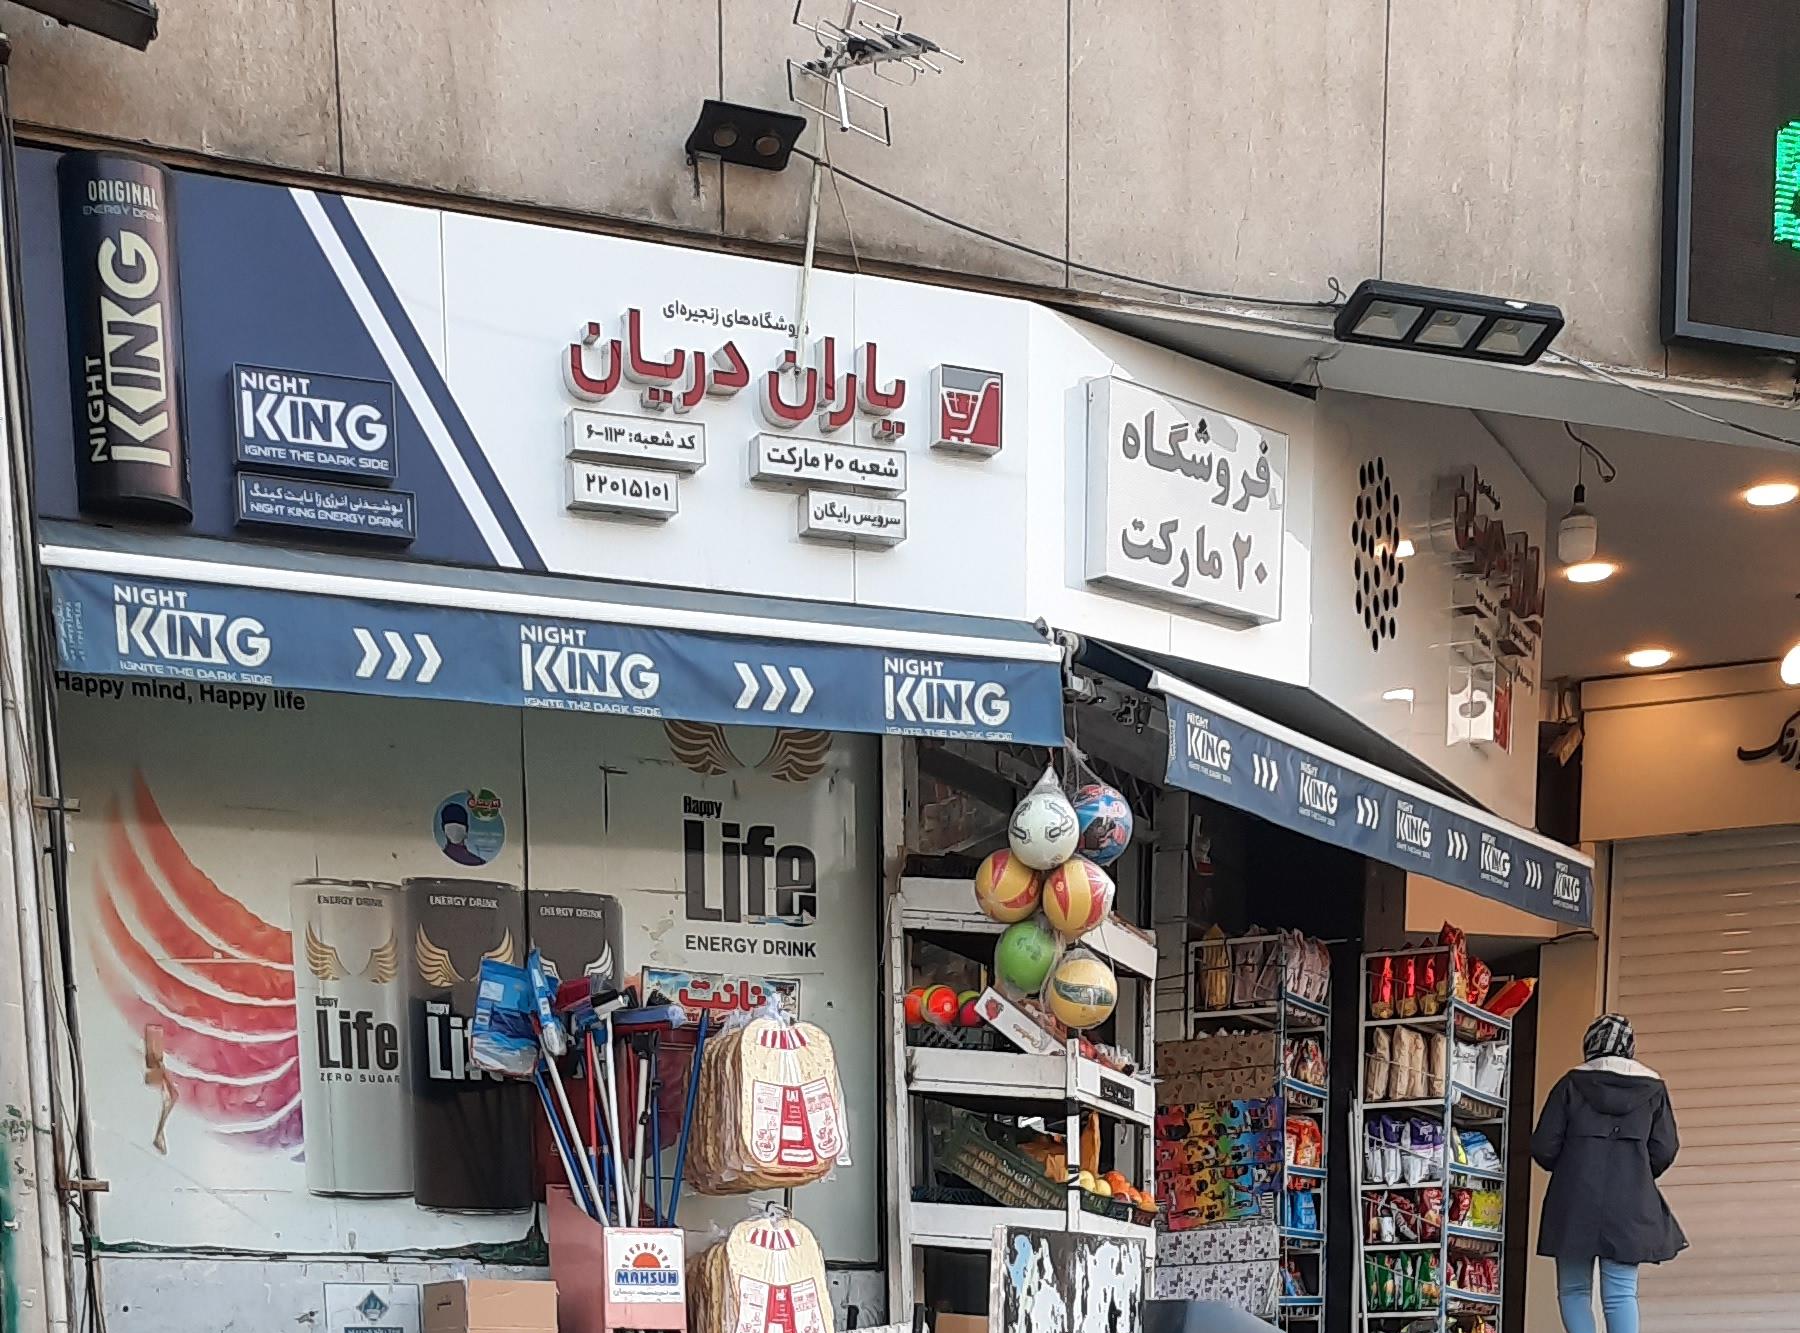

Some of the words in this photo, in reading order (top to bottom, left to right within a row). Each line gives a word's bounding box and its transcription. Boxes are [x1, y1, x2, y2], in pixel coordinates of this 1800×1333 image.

[87, 180, 159, 210] ORIGINAL
[98, 230, 171, 467] KING
[567, 307, 750, 408] دریان
[240, 371, 310, 395] NIGHT
[763, 336, 906, 437] یاران
[85, 355, 108, 462] NIGHT
[242, 390, 388, 451] KING
[677, 435, 695, 450] کد
[245, 445, 286, 459] IGNITE
[289, 450, 315, 462] THE
[317, 452, 356, 467] DARK
[359, 458, 389, 471] SIDE
[767, 447, 820, 473] مارکت
[824, 453, 844, 471] ۲۰
[850, 458, 899, 480] شعبه
[1122, 410, 1270, 512] فروشگاه
[585, 473, 669, 501] ۲۲۰۱۵۱۰۱
[250, 502, 285, 515] NIGHT
[288, 507, 317, 519] KING
[318, 510, 365, 525] ENERGY
[368, 516, 404, 530] DRINK
[814, 501, 850, 523] رایگان
[853, 512, 901, 528] سرویس
[1122, 519, 1222, 588] مارکت
[1233, 532, 1268, 591] ۲۰
[114, 584, 187, 608] NIGHT
[115, 604, 271, 667] KING
[521, 624, 586, 646] NIGHT
[120, 660, 163, 674] IGNITE
[167, 666, 195, 678] THE
[197, 668, 237, 682] DARK
[240, 673, 272, 685] SIDE
[521, 643, 660, 700] KING
[885, 656, 944, 677] NIGHT
[54, 673, 124, 700] Happy
[201, 685, 264, 712] Happy
[275, 690, 306, 711] life
[885, 675, 1010, 726] KING
[594, 702, 629, 714] DARK
[633, 705, 662, 717] SIDE
[1186, 724, 1232, 771] KING
[684, 796, 722, 818] Happy
[1299, 773, 1338, 815] KING
[1396, 809, 1432, 848] KING
[684, 819, 816, 927] Life
[1480, 842, 1511, 878] KING
[686, 935, 758, 954] ENERGY
[763, 940, 816, 957] DRINK
[316, 1010, 399, 1070] Life
[320, 1073, 352, 1082] ZERO
